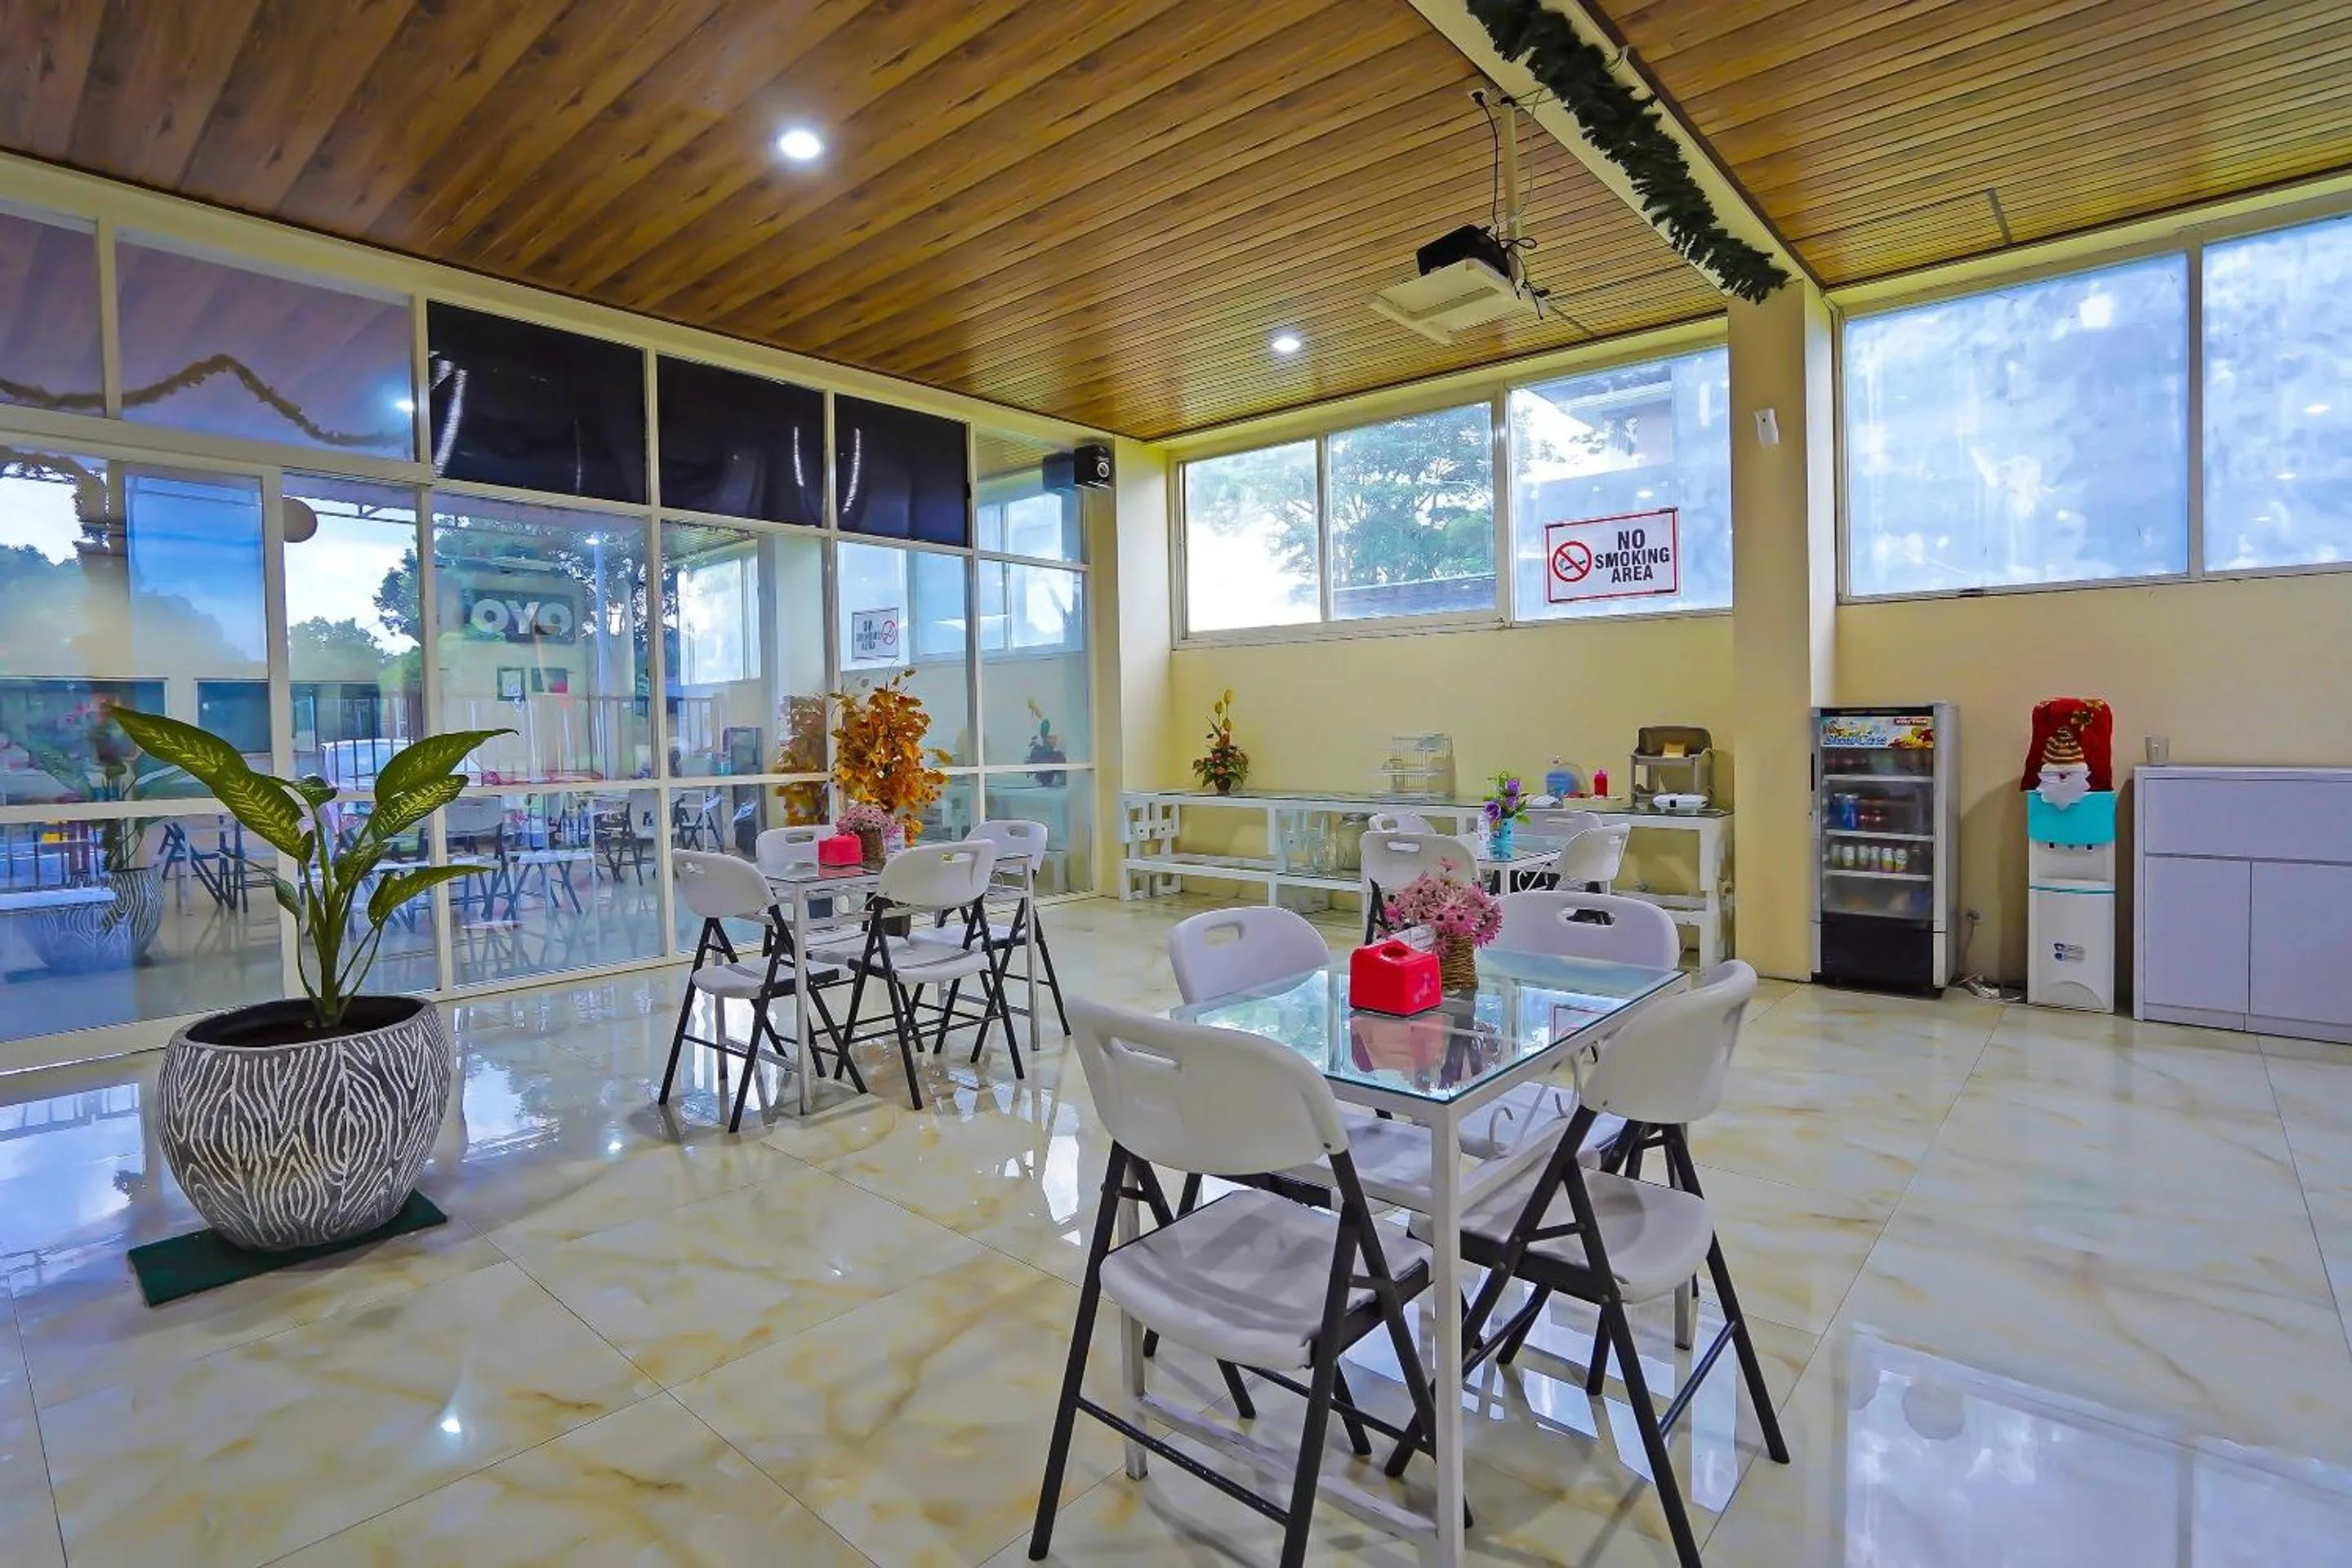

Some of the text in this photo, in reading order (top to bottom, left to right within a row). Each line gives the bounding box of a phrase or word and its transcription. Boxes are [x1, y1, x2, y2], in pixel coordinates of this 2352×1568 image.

[1618, 529, 1646, 550] NO
[1595, 547, 1670, 569] SMOKING
[1611, 564, 1653, 583] AREA
[470, 599, 573, 635] OYO
